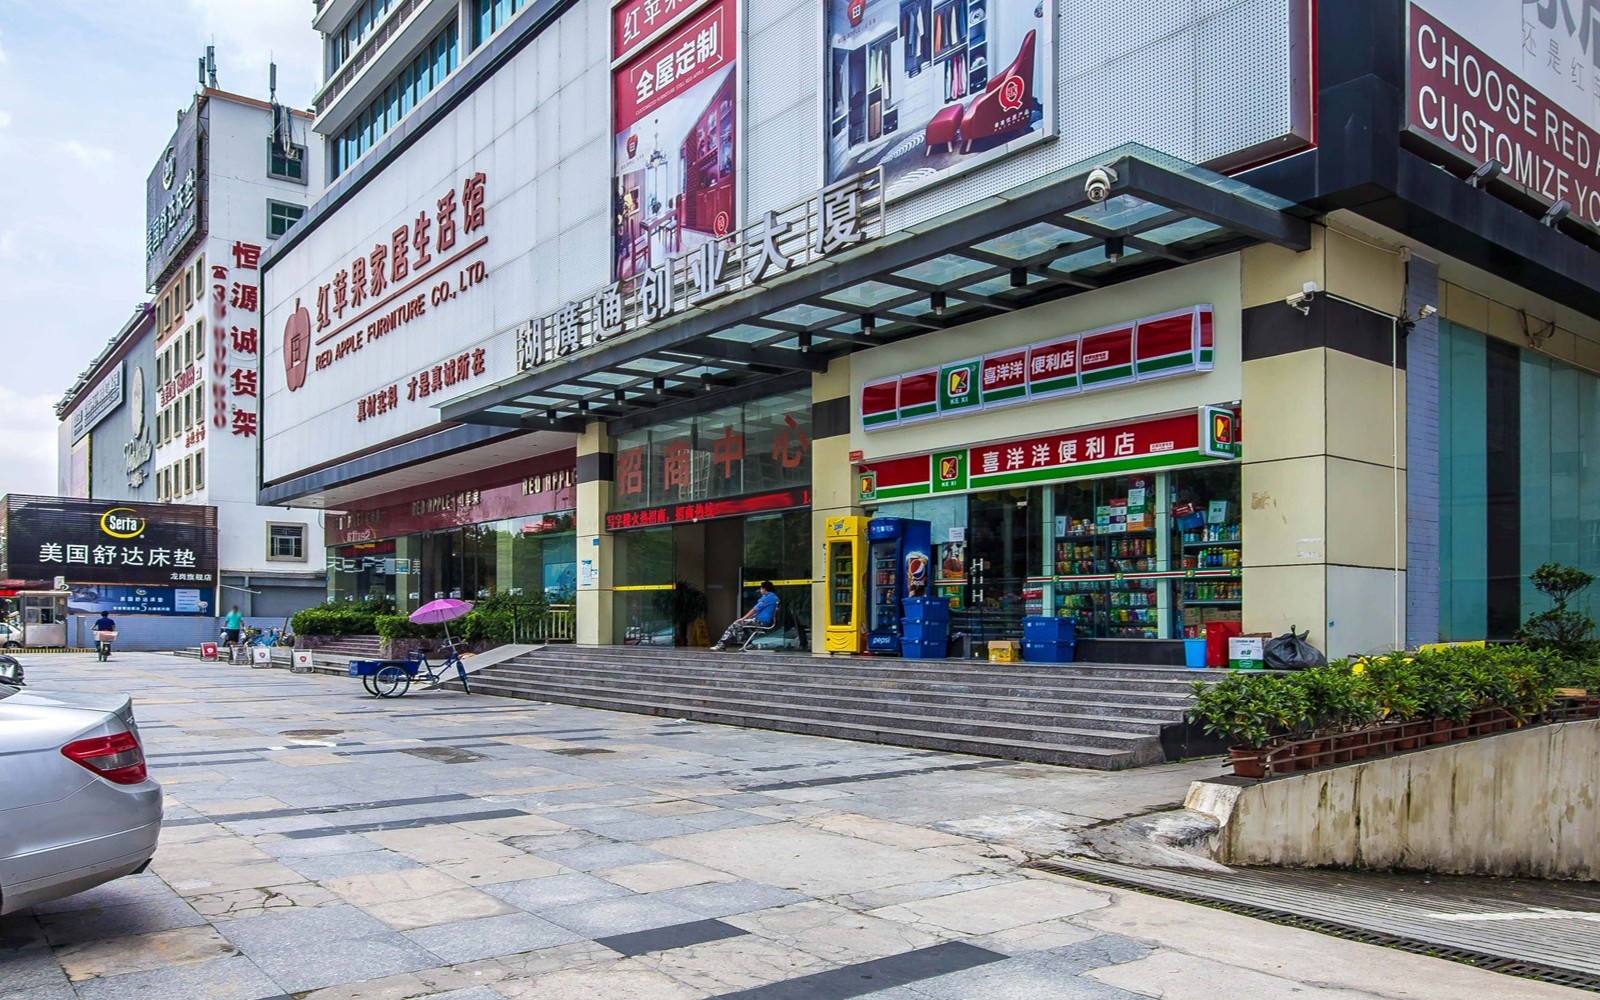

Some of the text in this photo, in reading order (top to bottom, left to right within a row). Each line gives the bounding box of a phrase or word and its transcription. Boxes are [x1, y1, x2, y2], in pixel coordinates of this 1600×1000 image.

[636, 21, 718, 104] 全屋定制
[1418, 24, 1537, 137] CHOOSE
[1545, 108, 1590, 169] RED
[1419, 85, 1569, 201] CUSTOMIZE
[316, 172, 486, 333] 红苹果家居生活馆
[231, 240, 262, 438] 恒源诚货架
[315, 348, 333, 372] RED
[335, 330, 363, 361] APPLE
[367, 293, 426, 343] FURNITURE
[983, 351, 1075, 385] 喜洋洋便利店
[407, 348, 486, 401] 才是真诚所在
[616, 415, 809, 496] 招商中心
[982, 432, 1135, 473] 喜洋洋便利店
[39, 542, 196, 569] 美国舒达床垫
[109, 515, 138, 531] Serta
[872, 636, 891, 645] pepsi
